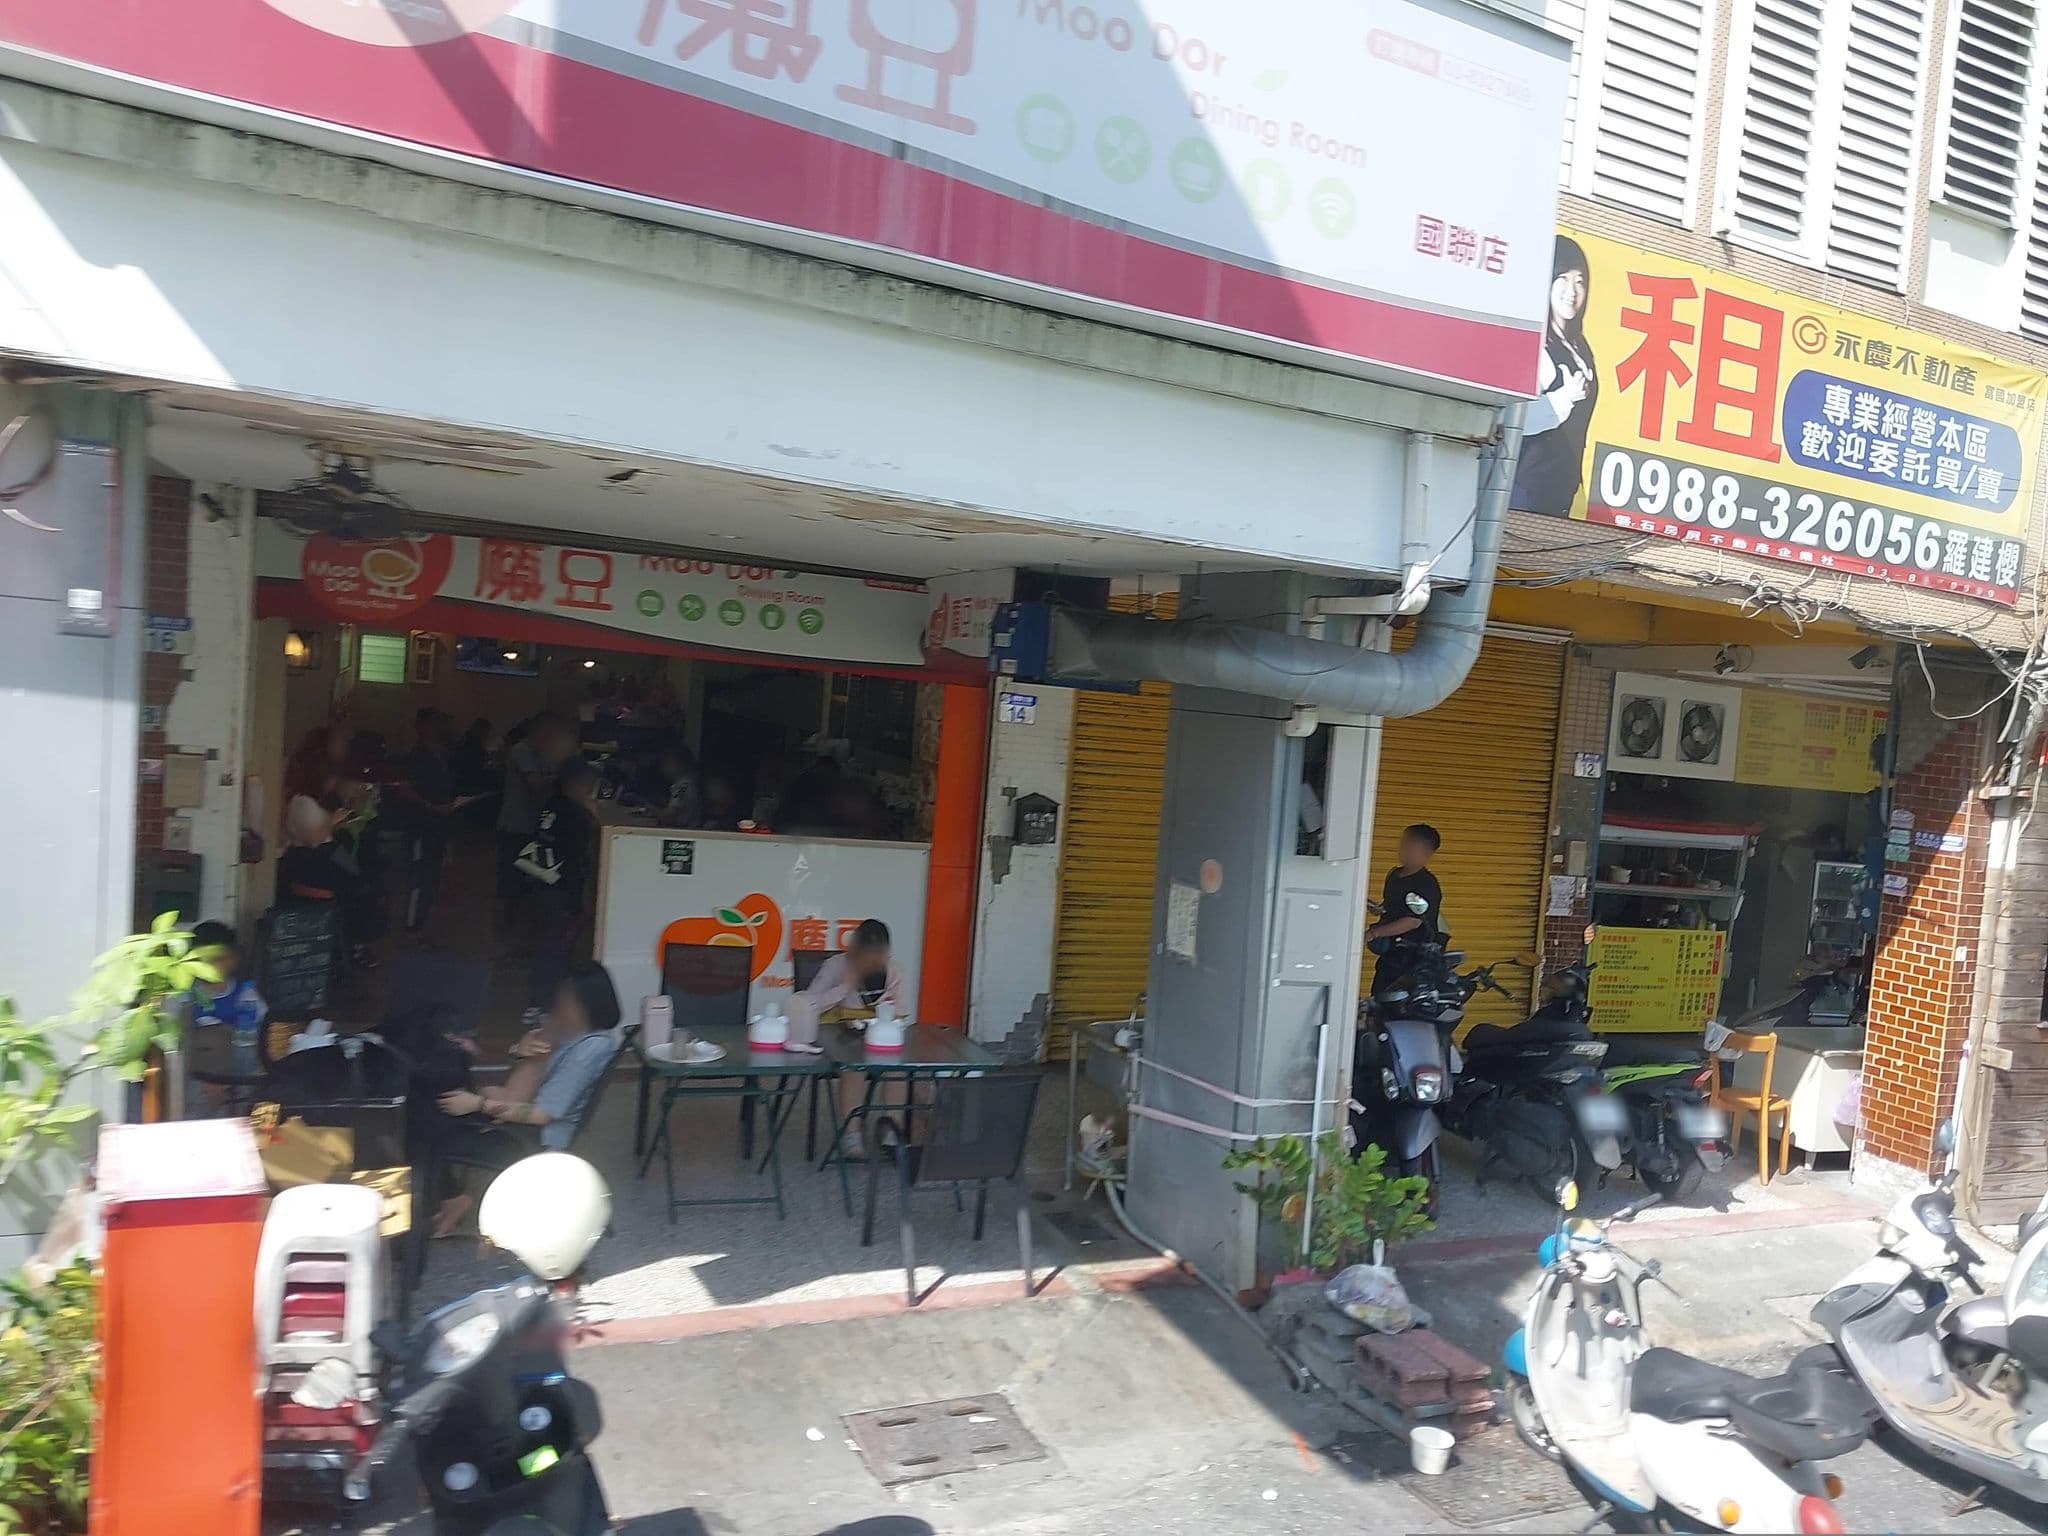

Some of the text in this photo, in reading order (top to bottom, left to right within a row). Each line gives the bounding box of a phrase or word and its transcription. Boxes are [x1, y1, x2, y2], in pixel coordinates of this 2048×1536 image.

[1151, 22, 1230, 77] Dor
[1188, 89, 1368, 169] Dining Room
[1415, 213, 1510, 275] 國聯店
[1615, 271, 1785, 464] 租
[1832, 328, 1979, 398] 永慶不動產
[1822, 382, 1991, 464] 專業經營本區
[1799, 420, 2005, 505] 歡迎委託買/賣
[1600, 450, 1943, 572] 0988-326056
[1008, 706, 1026, 723] 14
[1582, 763, 1595, 777] 12
